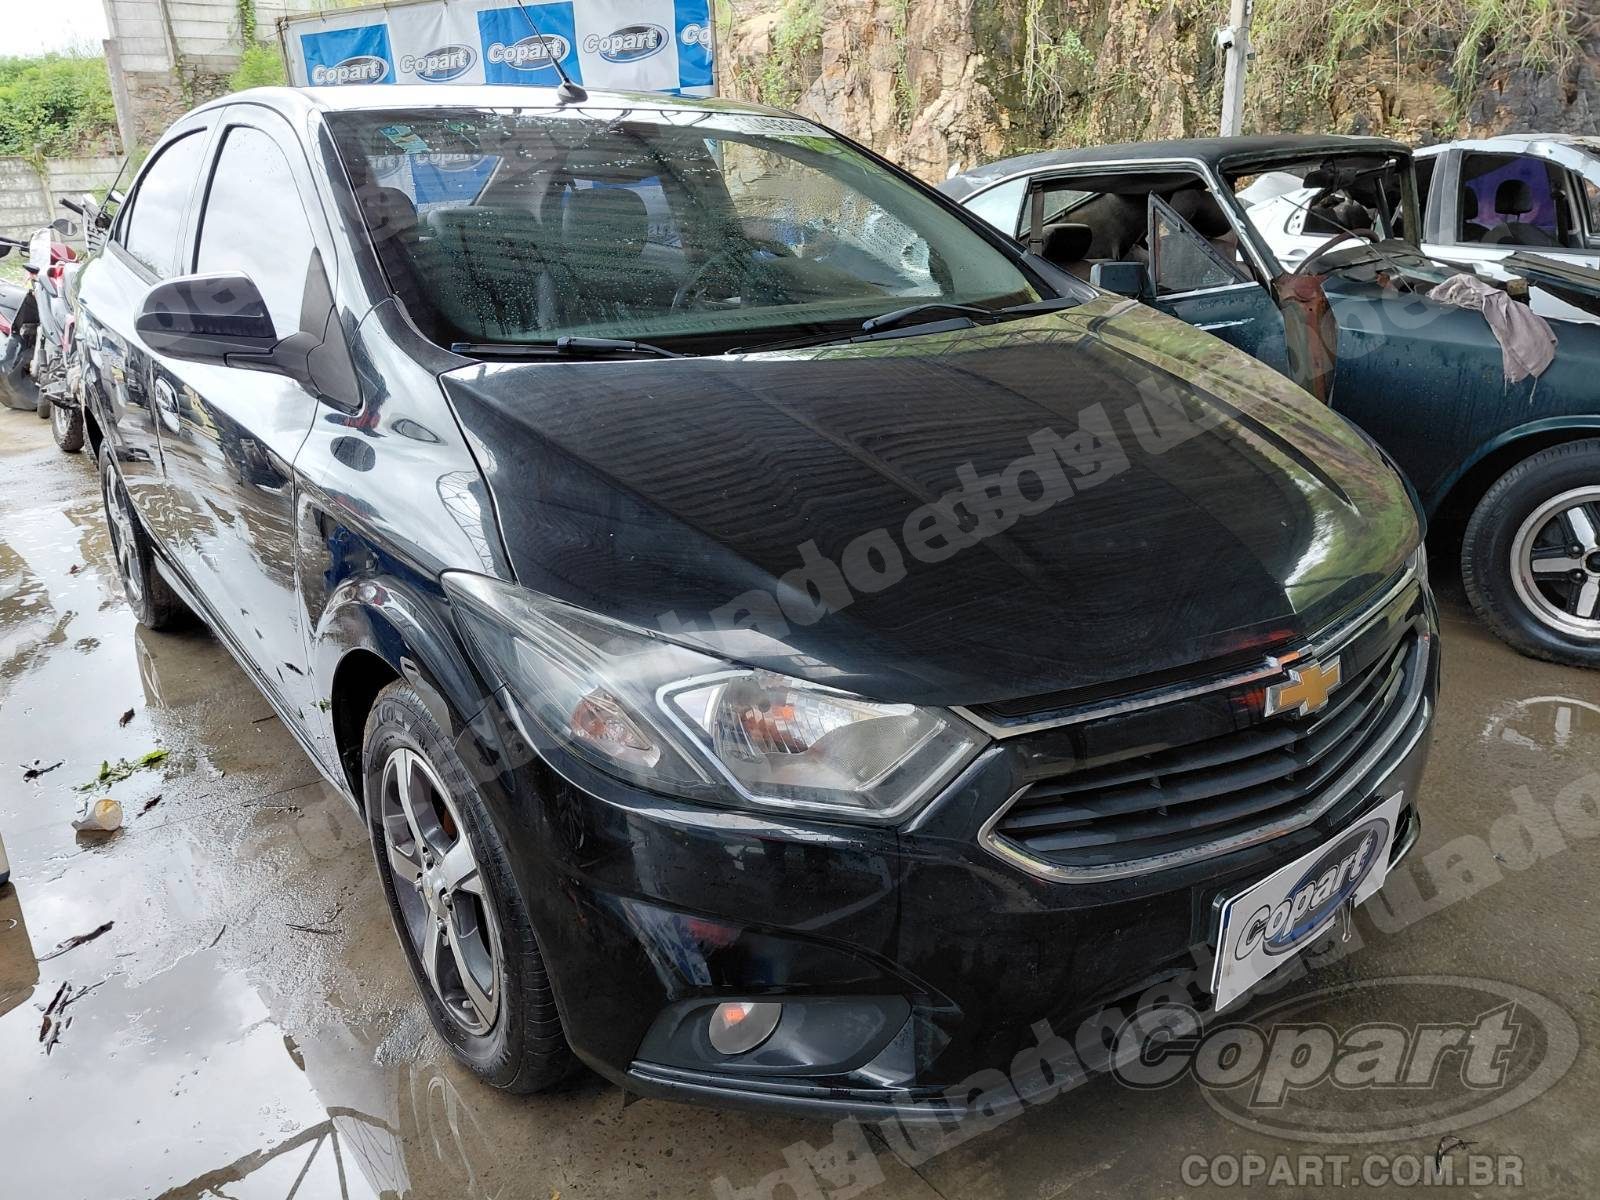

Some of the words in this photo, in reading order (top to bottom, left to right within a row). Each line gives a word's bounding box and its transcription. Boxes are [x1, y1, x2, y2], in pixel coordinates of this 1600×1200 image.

[487, 37, 563, 65] Copart
[583, 27, 658, 56] Copart
[311, 61, 381, 85] Copart
[400, 48, 468, 76] Copart
[1235, 828, 1374, 961] Copart
